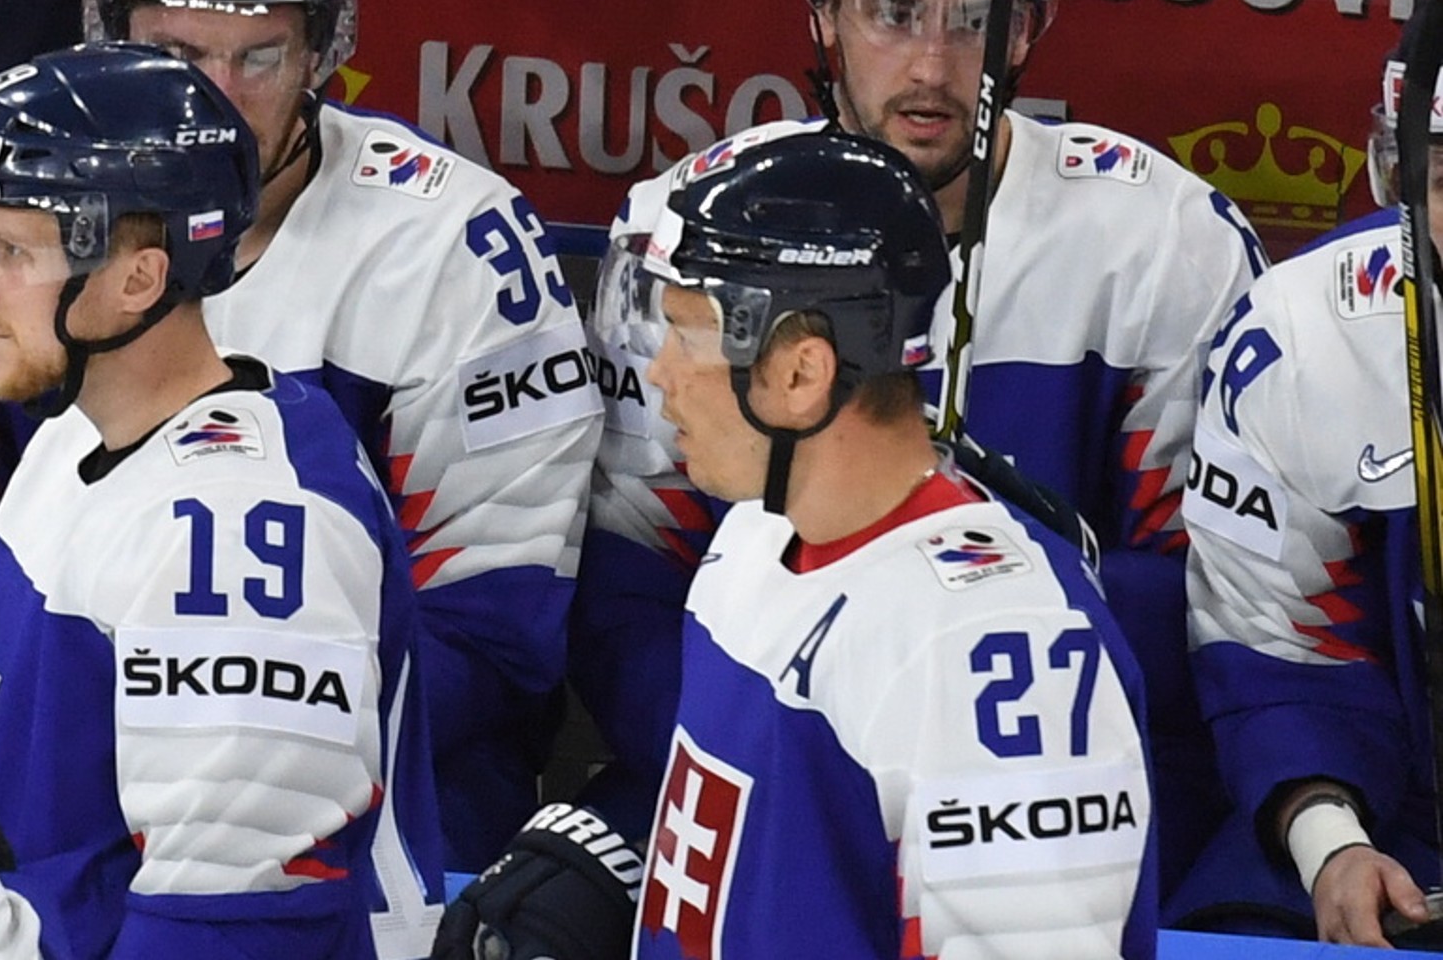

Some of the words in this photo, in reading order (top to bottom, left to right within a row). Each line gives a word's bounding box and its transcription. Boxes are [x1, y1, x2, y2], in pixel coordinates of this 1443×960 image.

[175, 127, 237, 146] CCM
[972, 72, 996, 162] CCM
[465, 195, 574, 326] 33
[777, 247, 873, 266] BAUER
[172, 497, 307, 621] 19
[122, 648, 353, 714] ŠKODA
[779, 592, 848, 700] A
[968, 627, 1102, 759] 27
[925, 788, 1138, 852] ŠKODA
